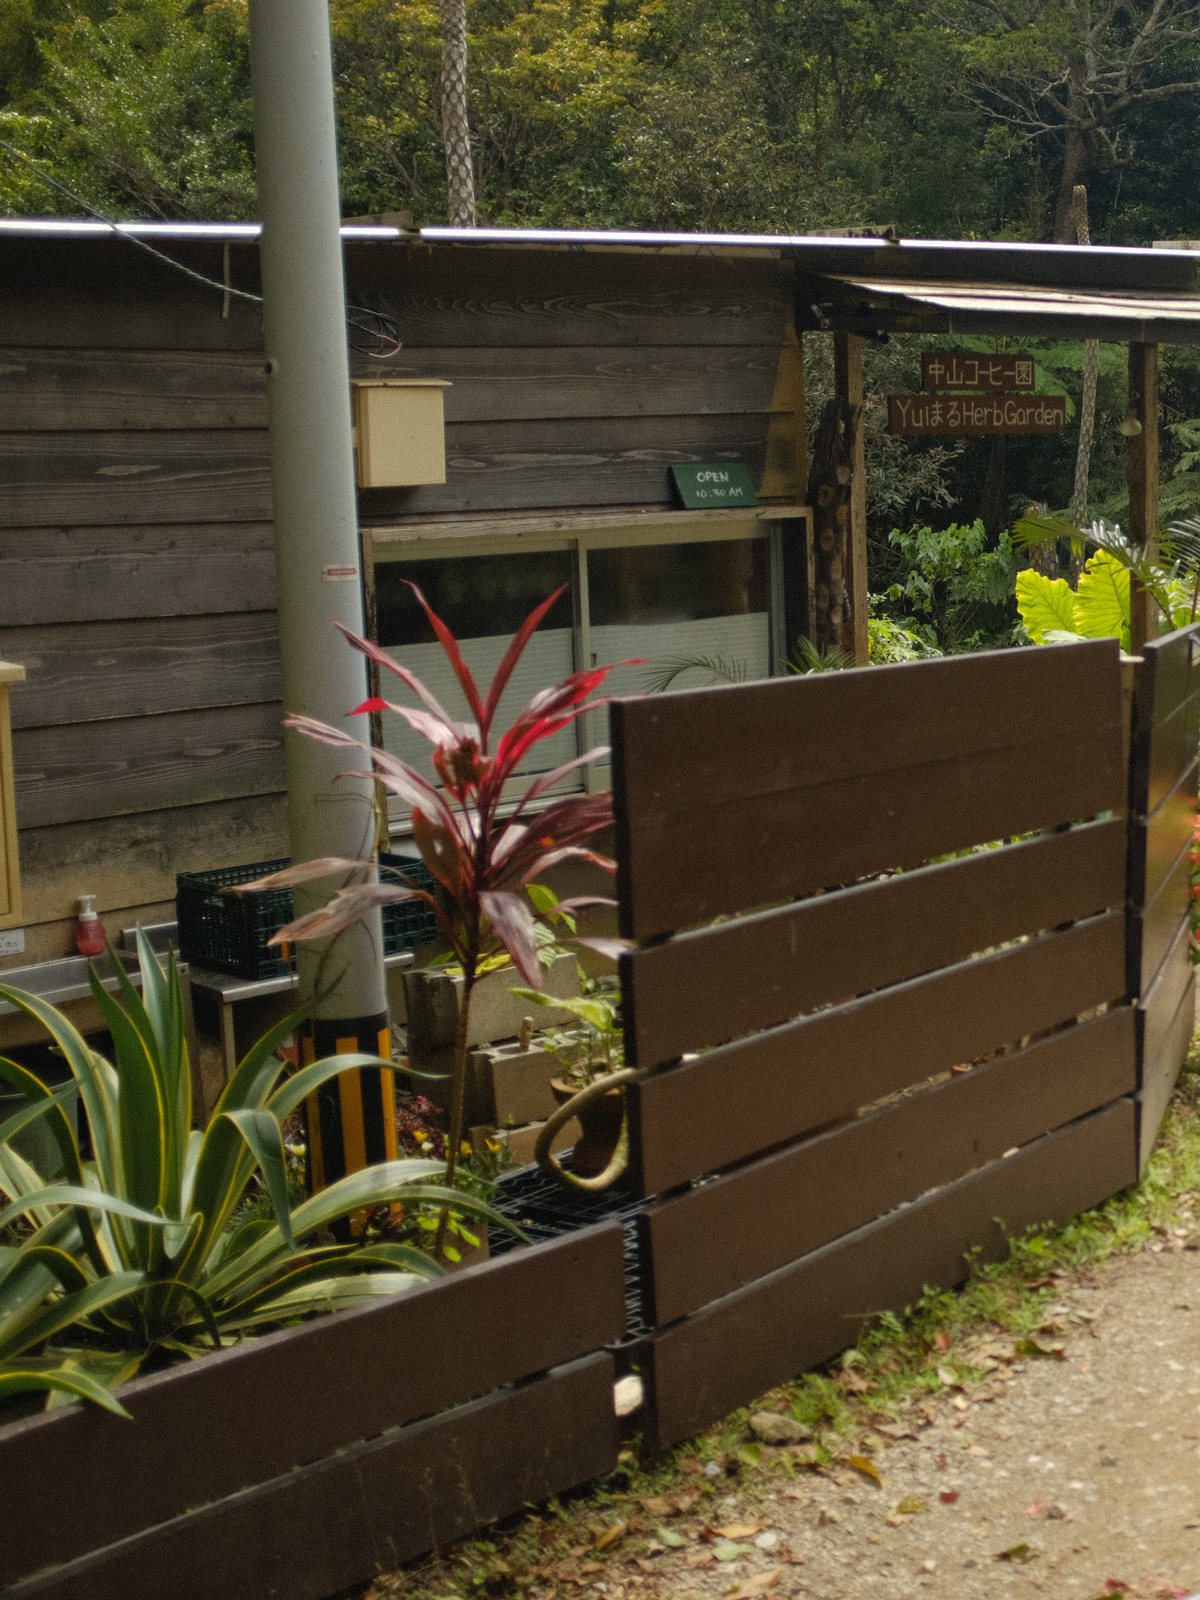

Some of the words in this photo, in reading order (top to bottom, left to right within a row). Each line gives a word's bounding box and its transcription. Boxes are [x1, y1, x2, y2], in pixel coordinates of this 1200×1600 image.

[928, 358, 1032, 386] 中山コーヒー園
[696, 471, 729, 483] OPEN
